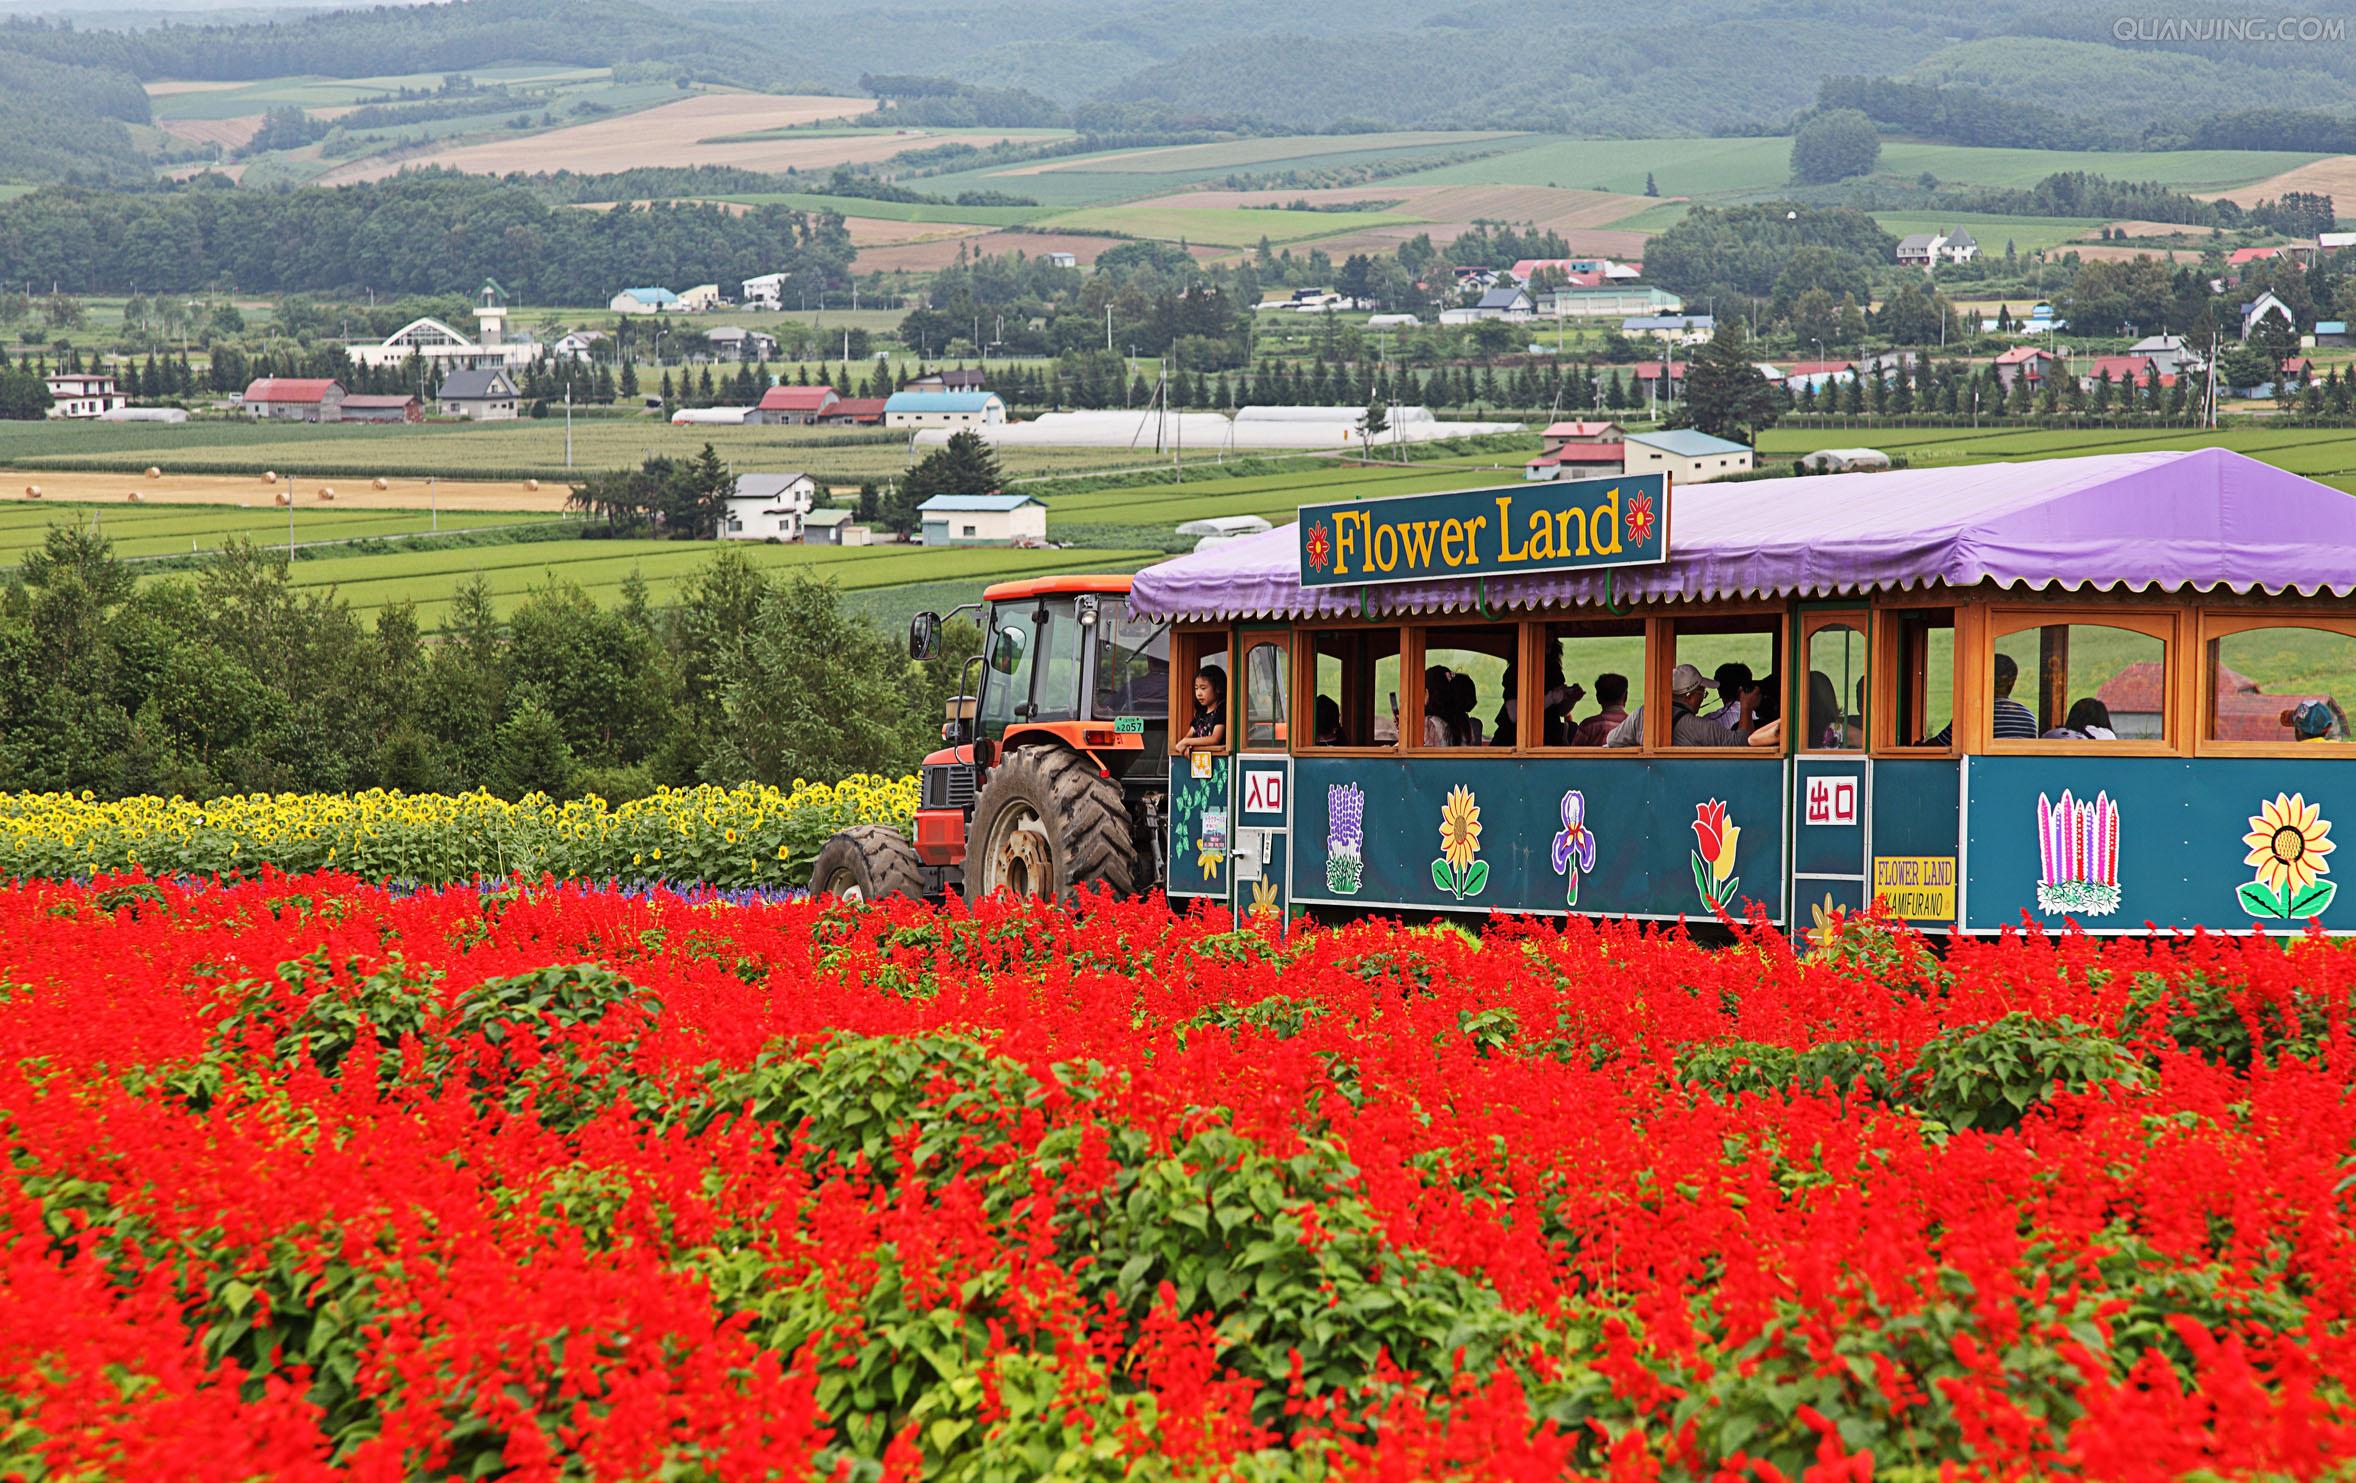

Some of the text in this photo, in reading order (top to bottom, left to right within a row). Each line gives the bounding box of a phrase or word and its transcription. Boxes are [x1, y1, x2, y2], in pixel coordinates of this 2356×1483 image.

[1332, 487, 1622, 575] Flower Land
[1121, 723, 1142, 732] 2057
[1247, 774, 1280, 809] 入口
[1809, 781, 1854, 822] 出口
[1878, 861, 1953, 886] FLOWER LAND
[1885, 892, 1943, 916] KAMIFURANO
